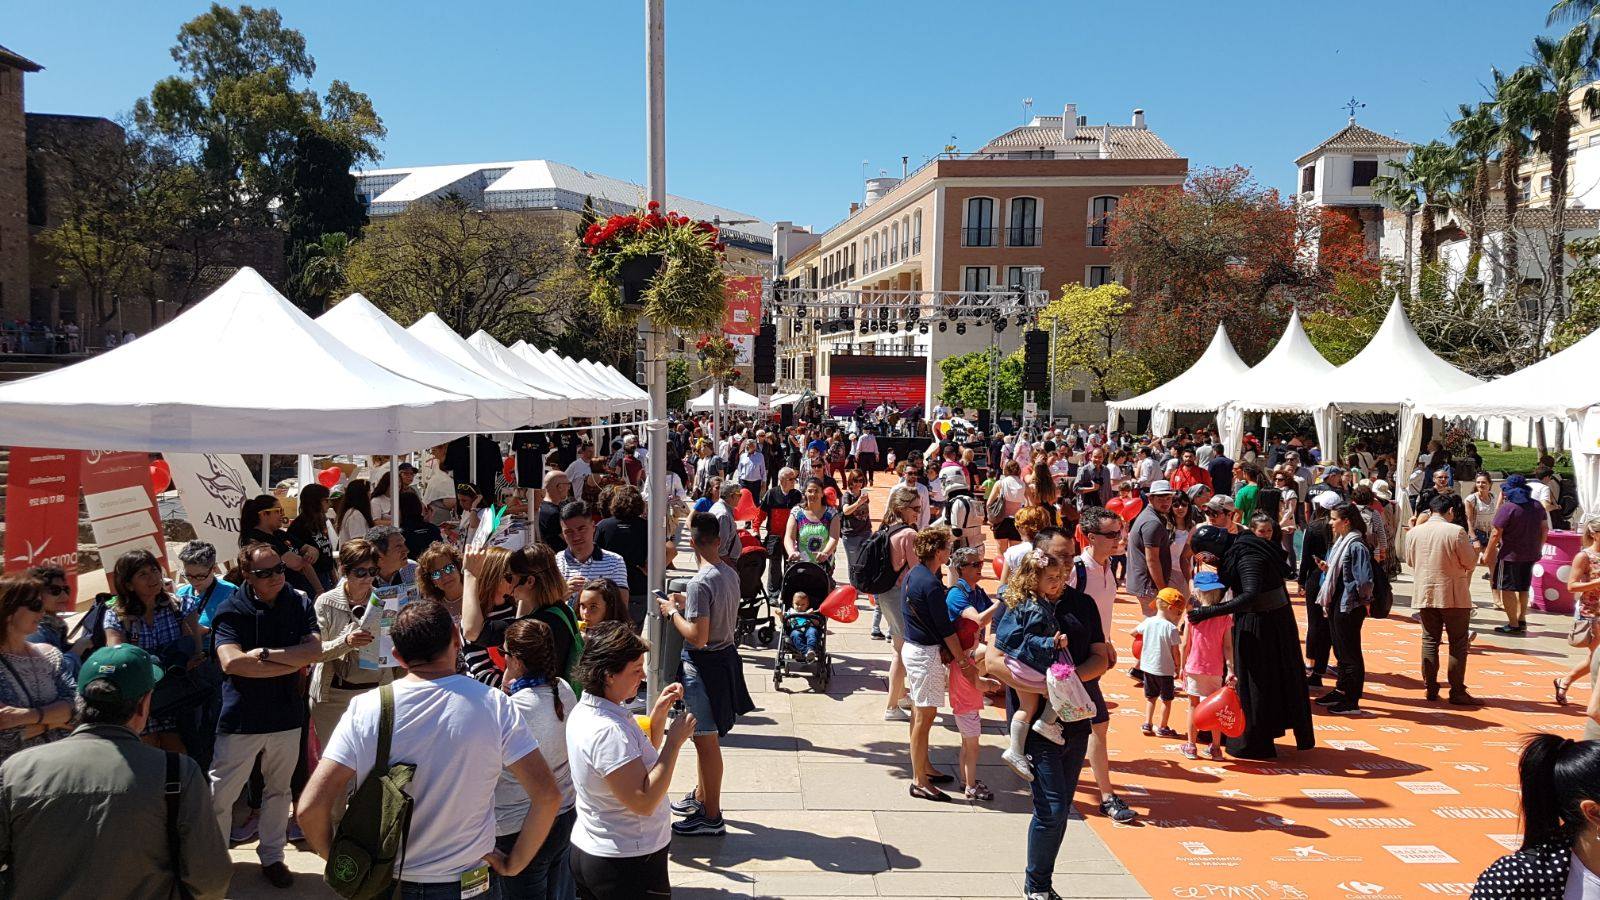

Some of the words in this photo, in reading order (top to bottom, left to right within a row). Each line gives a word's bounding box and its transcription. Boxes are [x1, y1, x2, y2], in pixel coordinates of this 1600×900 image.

[203, 511, 241, 532] AMU
[1432, 810, 1520, 819] VICTORIA
[1328, 818, 1417, 826] VICTORIA
